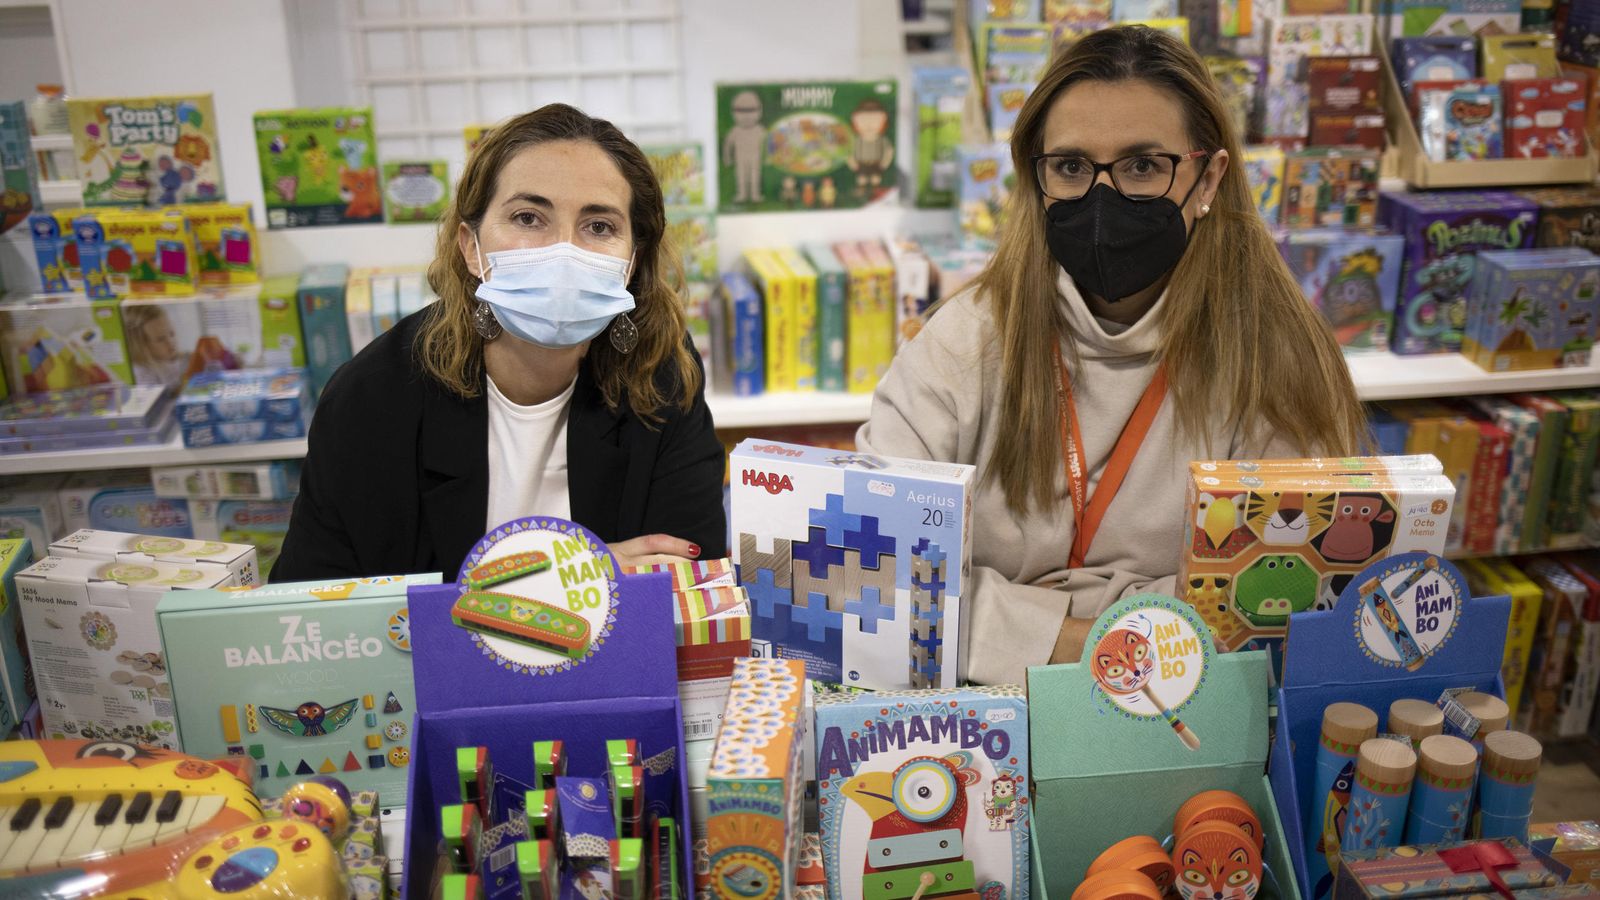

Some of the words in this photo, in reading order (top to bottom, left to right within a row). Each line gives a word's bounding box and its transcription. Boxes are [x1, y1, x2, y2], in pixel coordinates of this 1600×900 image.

[781, 87, 836, 108] MUMMY
[105, 106, 175, 126] Tom's
[110, 122, 180, 145] Party
[742, 469, 794, 495] HABA
[907, 490, 956, 508] Aerius
[922, 508, 943, 527] 20
[1414, 519, 1435, 527] Octo
[558, 553, 616, 589] MAM
[35, 596, 54, 604] Mood
[57, 598, 78, 606] Memo
[566, 586, 601, 612] BO
[1415, 596, 1452, 615] MAM
[279, 615, 321, 645] ZE
[1415, 616, 1440, 634] BO
[224, 632, 383, 668] BALANCÉO
[1157, 637, 1198, 662] MAM
[1160, 660, 1186, 681] BO
